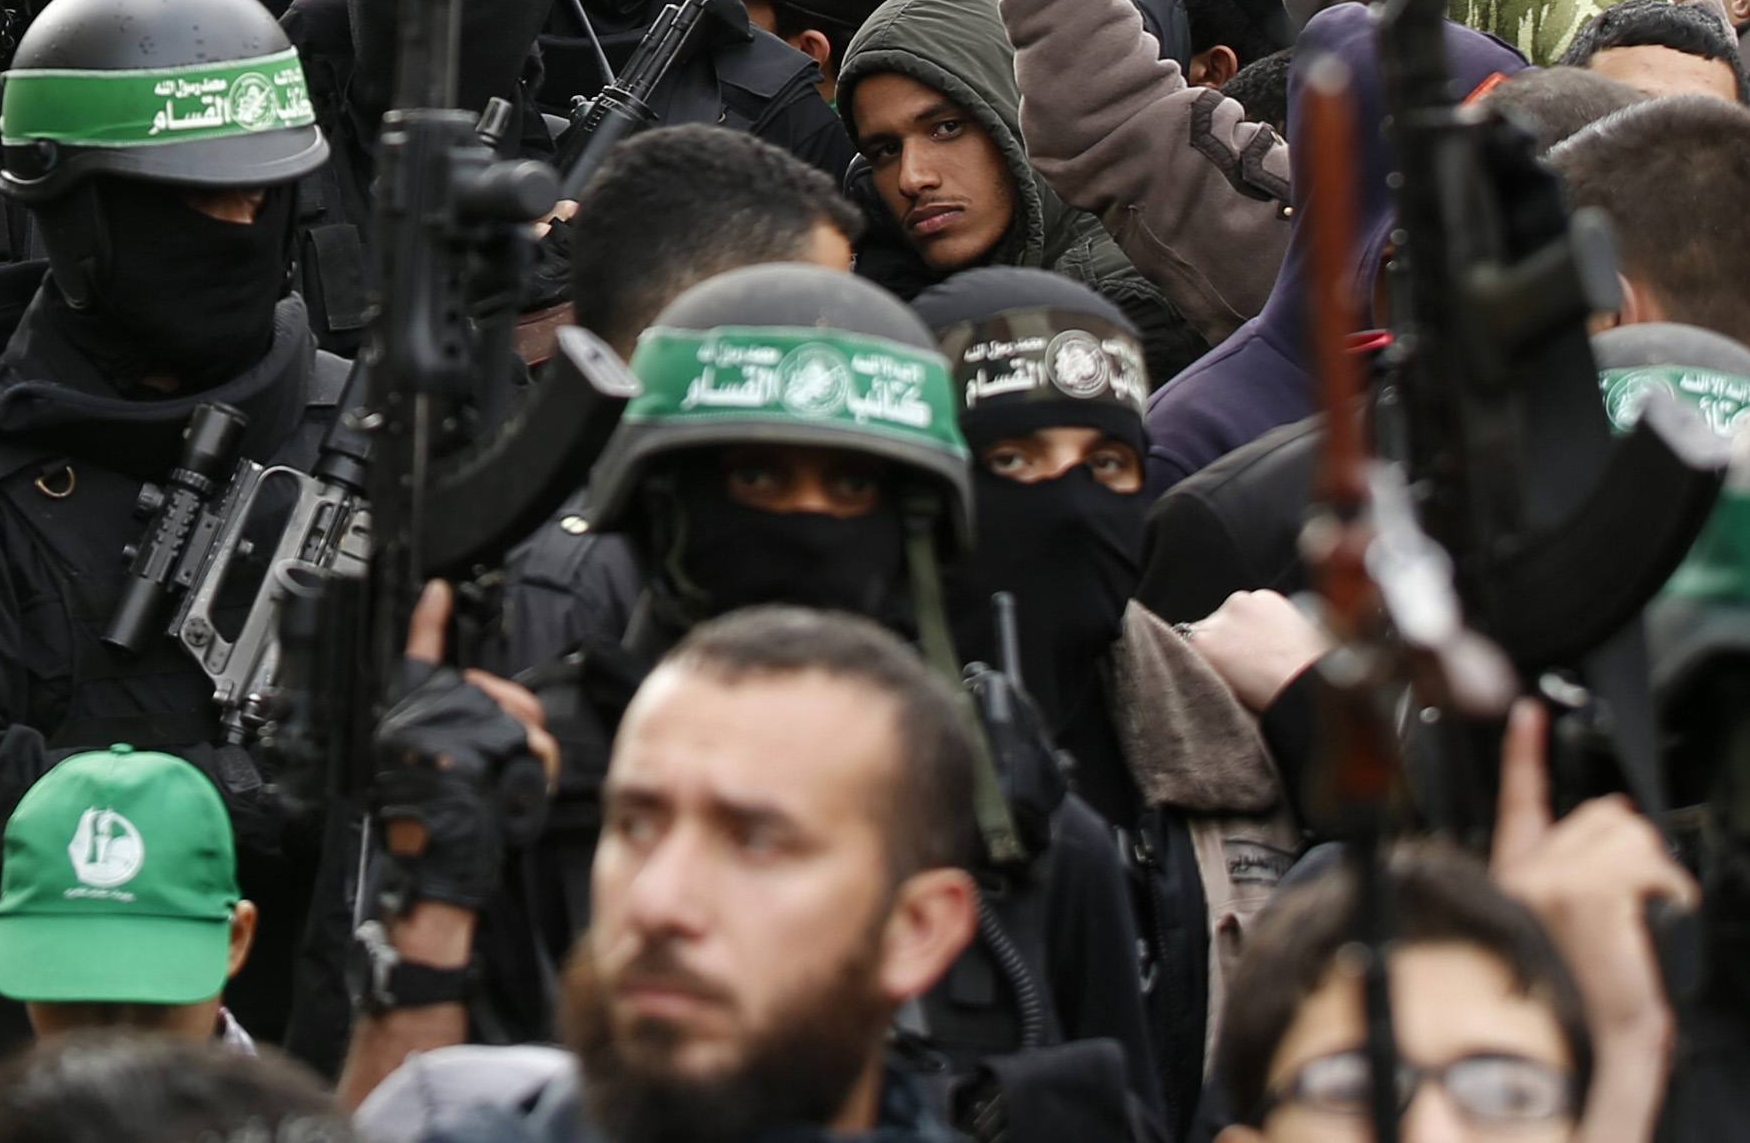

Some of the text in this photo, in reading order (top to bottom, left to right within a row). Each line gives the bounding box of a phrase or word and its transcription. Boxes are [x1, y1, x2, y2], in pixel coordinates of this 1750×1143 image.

[148, 95, 233, 135] القسام
[679, 365, 933, 429] كتائب القسام
[966, 358, 1047, 408] القسام
